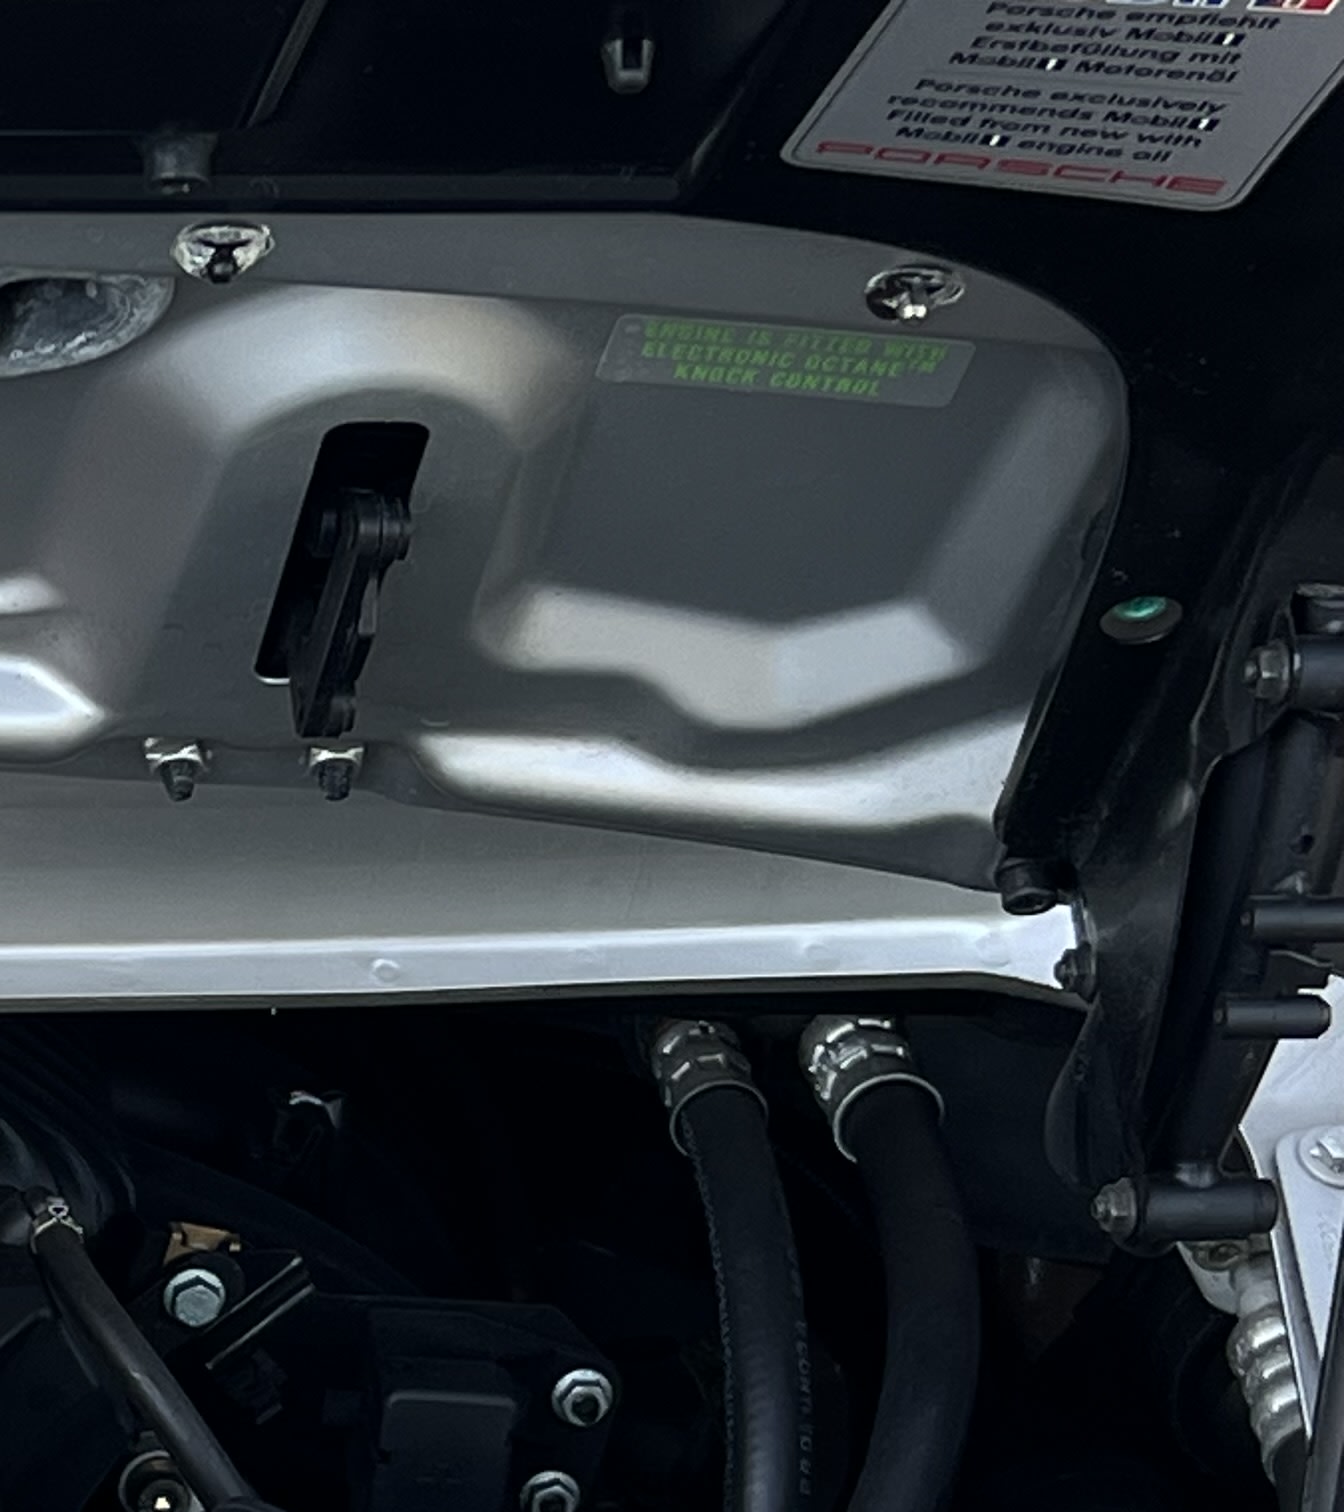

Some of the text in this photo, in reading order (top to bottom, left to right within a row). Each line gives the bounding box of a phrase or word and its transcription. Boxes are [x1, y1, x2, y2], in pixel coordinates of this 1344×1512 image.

[984, 21, 1118, 40] exklusiv
[985, 1, 1117, 21] Porsche
[1124, 10, 1281, 31] empfiehlt
[970, 36, 1243, 66] Erstbefüllung mit
[1074, 60, 1241, 84] Motorenöl
[886, 93, 1094, 122] recommends
[914, 78, 1230, 118] Porsche exclusively
[885, 110, 1204, 149] Filled from new with
[1015, 137, 1125, 161] engine
[1130, 145, 1174, 164] oil
[816, 141, 1226, 195] PORSCHE
[746, 328, 773, 348] IS
[640, 340, 795, 369] ELECTRONIC
[672, 363, 883, 398] KNOCK CONTROL
